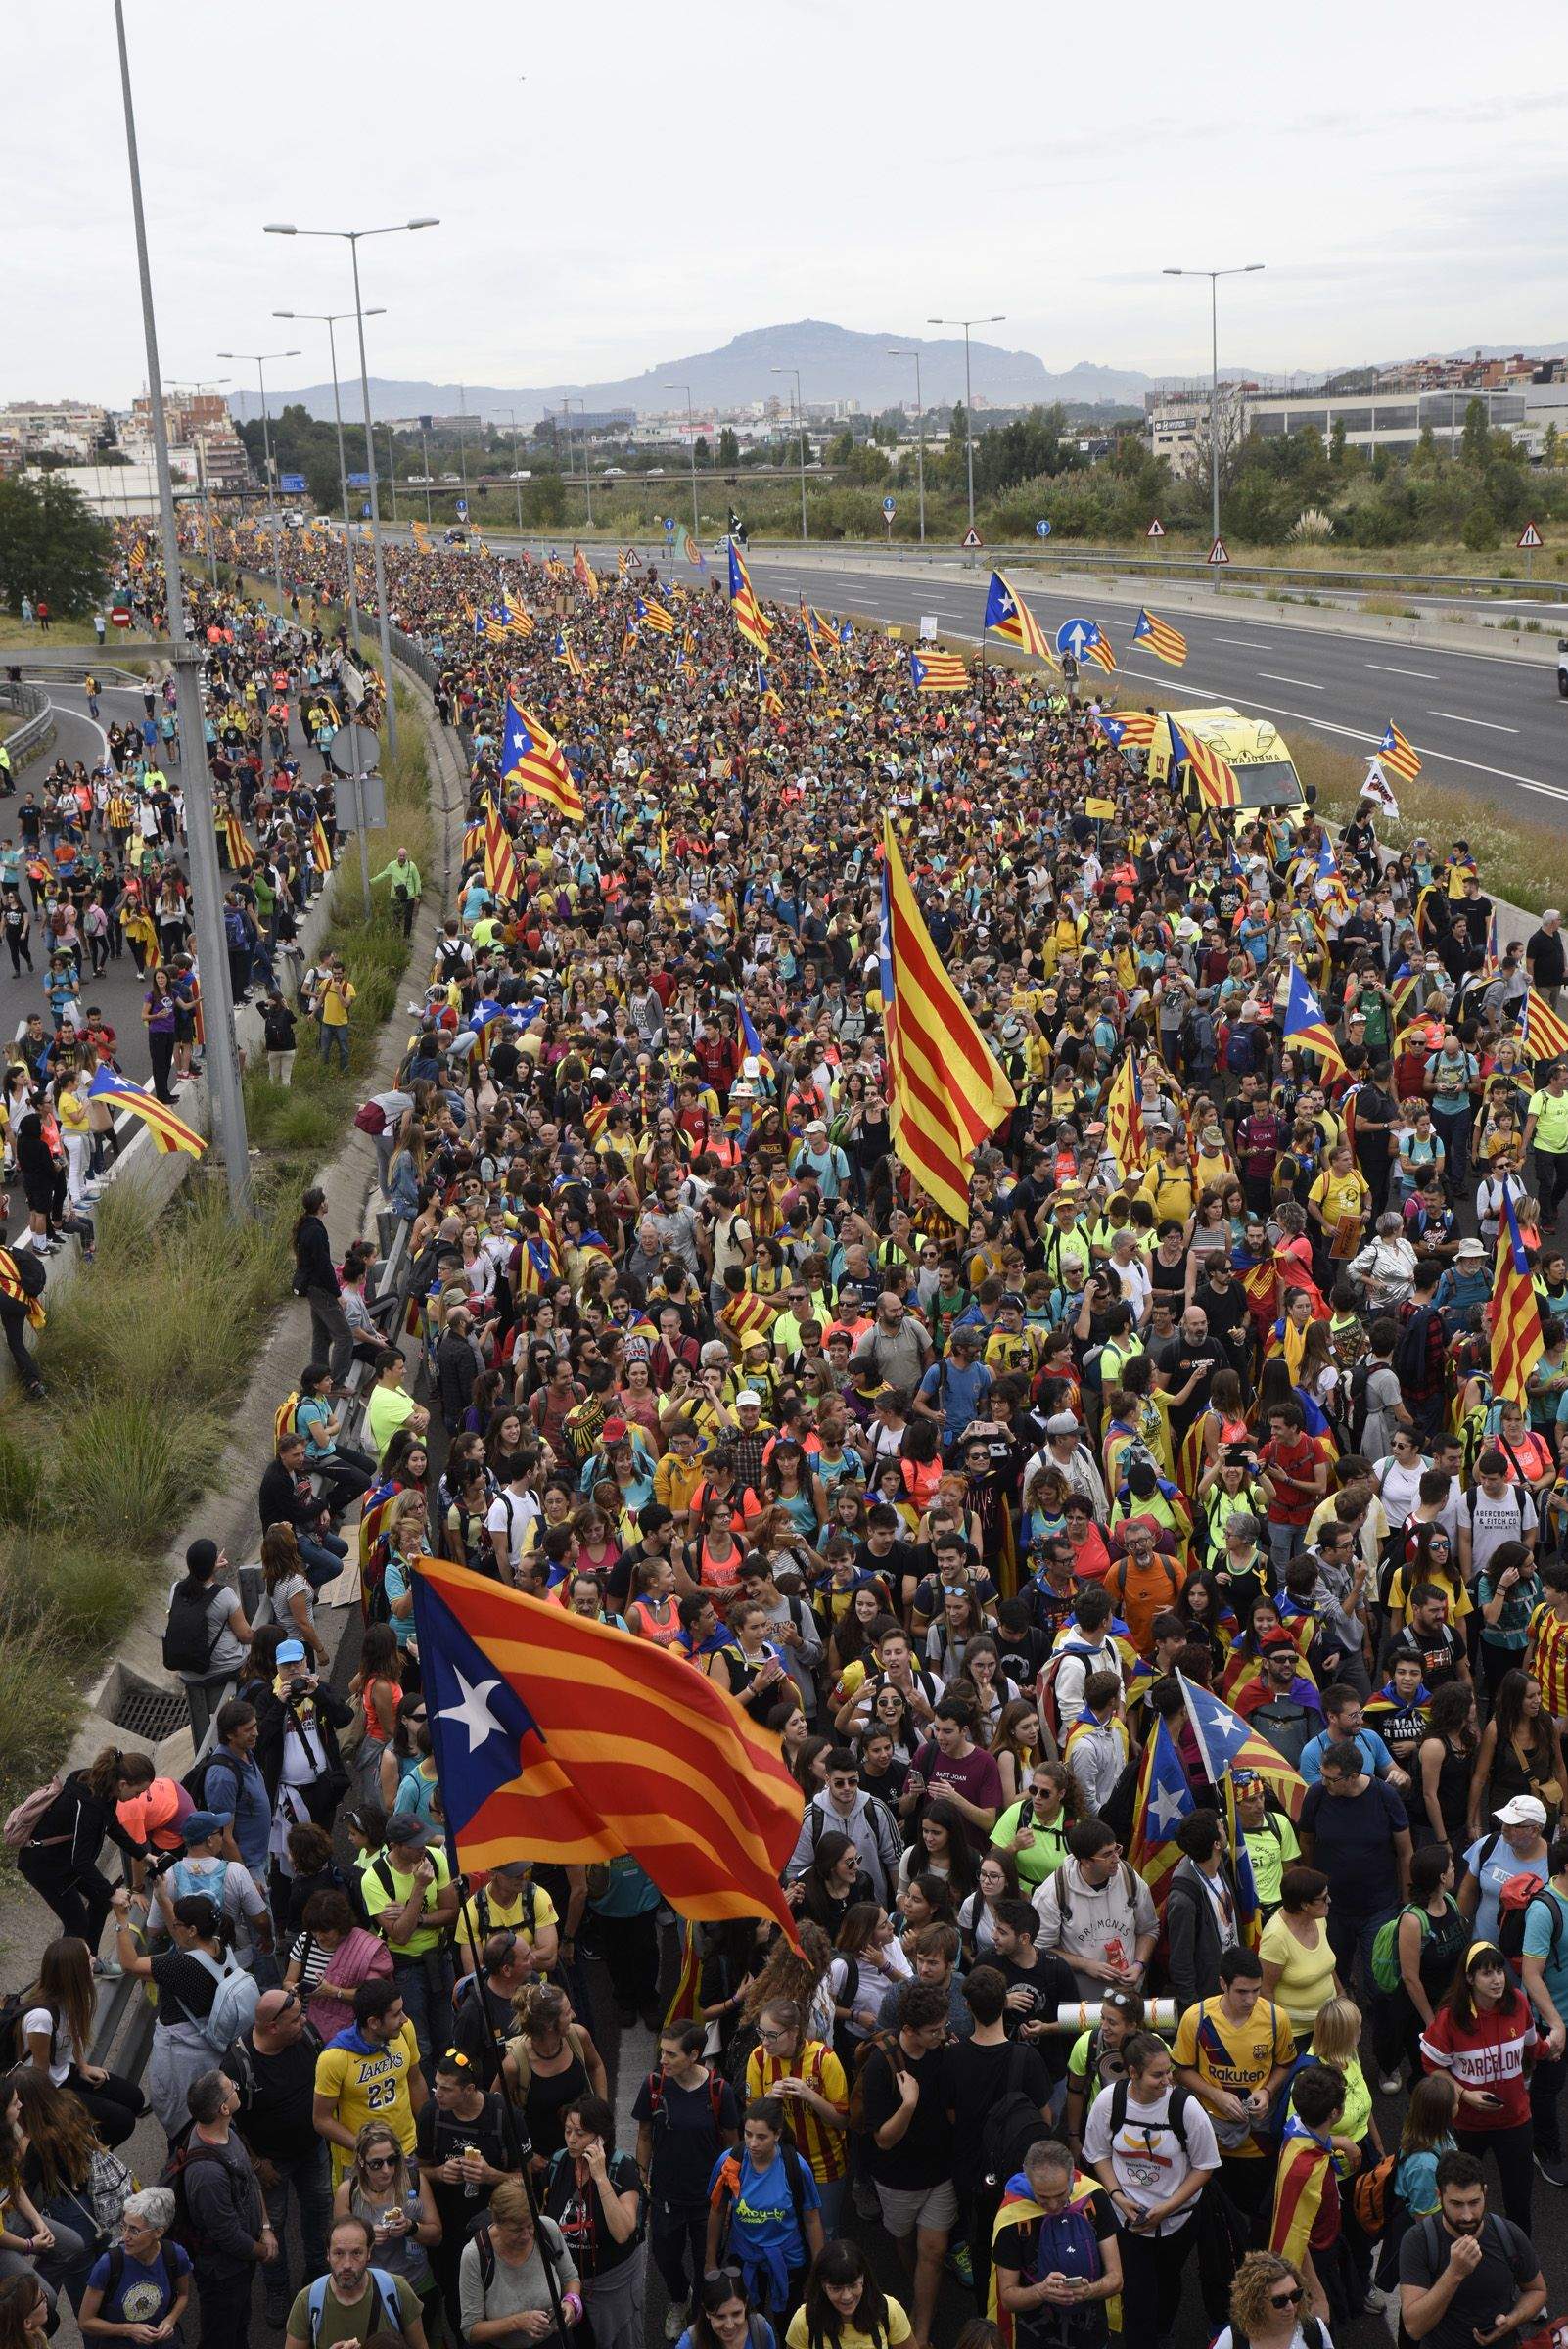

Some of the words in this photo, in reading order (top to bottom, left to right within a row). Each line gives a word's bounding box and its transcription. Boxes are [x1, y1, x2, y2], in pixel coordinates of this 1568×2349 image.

[1384, 1728, 1391, 1737] a
[355, 2051, 403, 2085] LAKERS
[1208, 2065, 1265, 2083] Rakuten
[1459, 2048, 1521, 2076] BARCELON
[368, 2077, 397, 2109] 23
